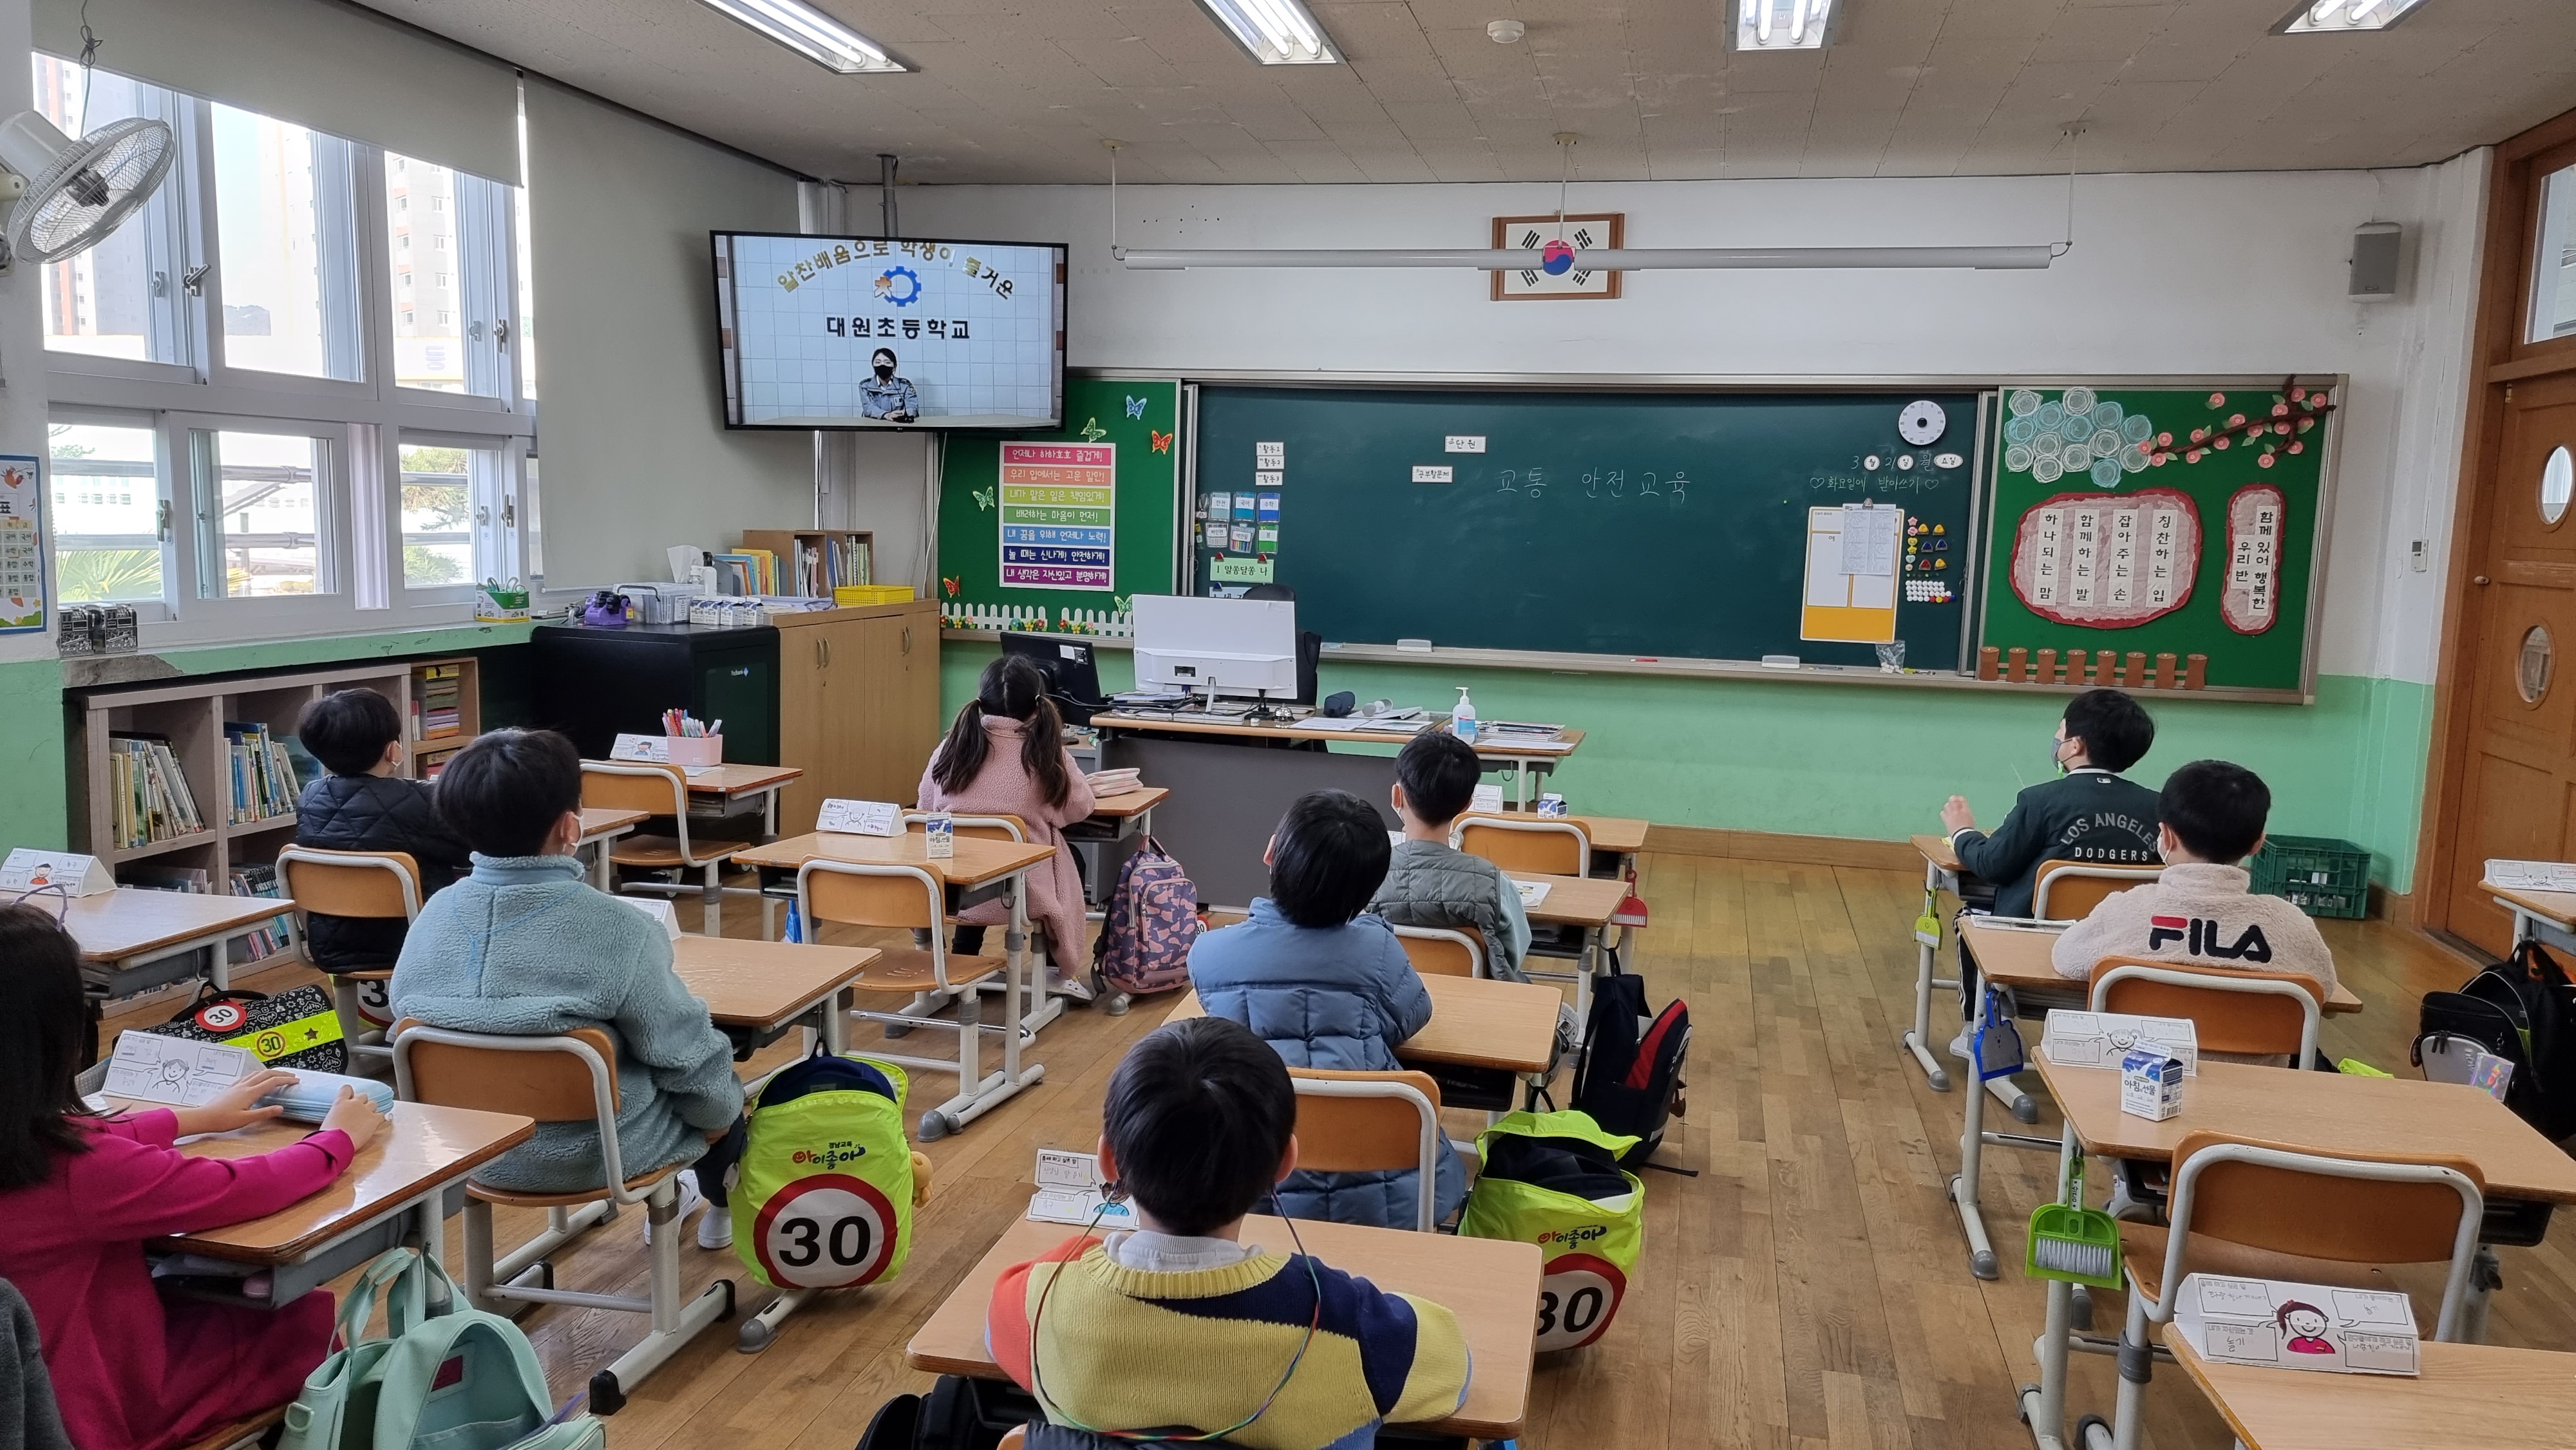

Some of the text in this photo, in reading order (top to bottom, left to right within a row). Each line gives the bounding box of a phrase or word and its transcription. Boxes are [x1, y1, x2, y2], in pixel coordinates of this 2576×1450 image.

[777, 240, 1014, 300] 알찬배움으로 학생이 즐거운
[826, 317, 970, 339] 대원초등학교
[1012, 449, 1103, 462] 언제나 하하호호 즐겁게!
[1850, 455, 1859, 469] 3
[1885, 456, 1897, 471] 21
[1942, 457, 1956, 466] 요일
[1010, 469, 1025, 479] 우리
[1030, 470, 1061, 481] 입에서는
[1066, 471, 1081, 481] 고운
[1497, 466, 1690, 504] 교통 안전 교육
[1827, 476, 1919, 494] 화요일에 받아쓰기
[1010, 489, 1026, 498] 내가
[1050, 491, 1065, 502] 일은
[1070, 491, 1104, 502] 책임있게!
[1016, 509, 1098, 523] 배려하는 마음이 먼저!
[1007, 529, 1106, 543] 내 꿈을 위해 언제나 노력!
[1021, 549, 1036, 560] 때는
[1041, 550, 1066, 561] 신나게!
[1072, 551, 1105, 563] 안전하게!
[2040, 514, 2058, 599] 하나되는 맘
[2076, 514, 2094, 601] 함께하는 발
[2114, 515, 2132, 601] 잡아주는 손
[2153, 516, 2170, 602] 칭찬하는 입
[2235, 541, 2251, 582] 우리 반
[2252, 511, 2273, 609] 함께 있어 행복한
[1018, 569, 1039, 580] 생각은
[1043, 570, 1072, 581] 자신있고
[1076, 571, 1106, 583] 분명하게!
[1224, 565, 1256, 576] 알쏭달쏭
[1260, 567, 1267, 576] 나
[2060, 813, 2158, 853] LOS ANGELES
[2075, 847, 2148, 862] DODGERS
[2149, 916, 2273, 964] FILA
[361, 979, 389, 1008] 3
[209, 1009, 232, 1024] 30
[261, 1036, 281, 1053] 30
[792, 1146, 866, 1170] 아이좋아
[779, 1216, 871, 1267] 30
[1537, 1226, 1607, 1250] 아이좋아
[1537, 1286, 1603, 1336] 30
